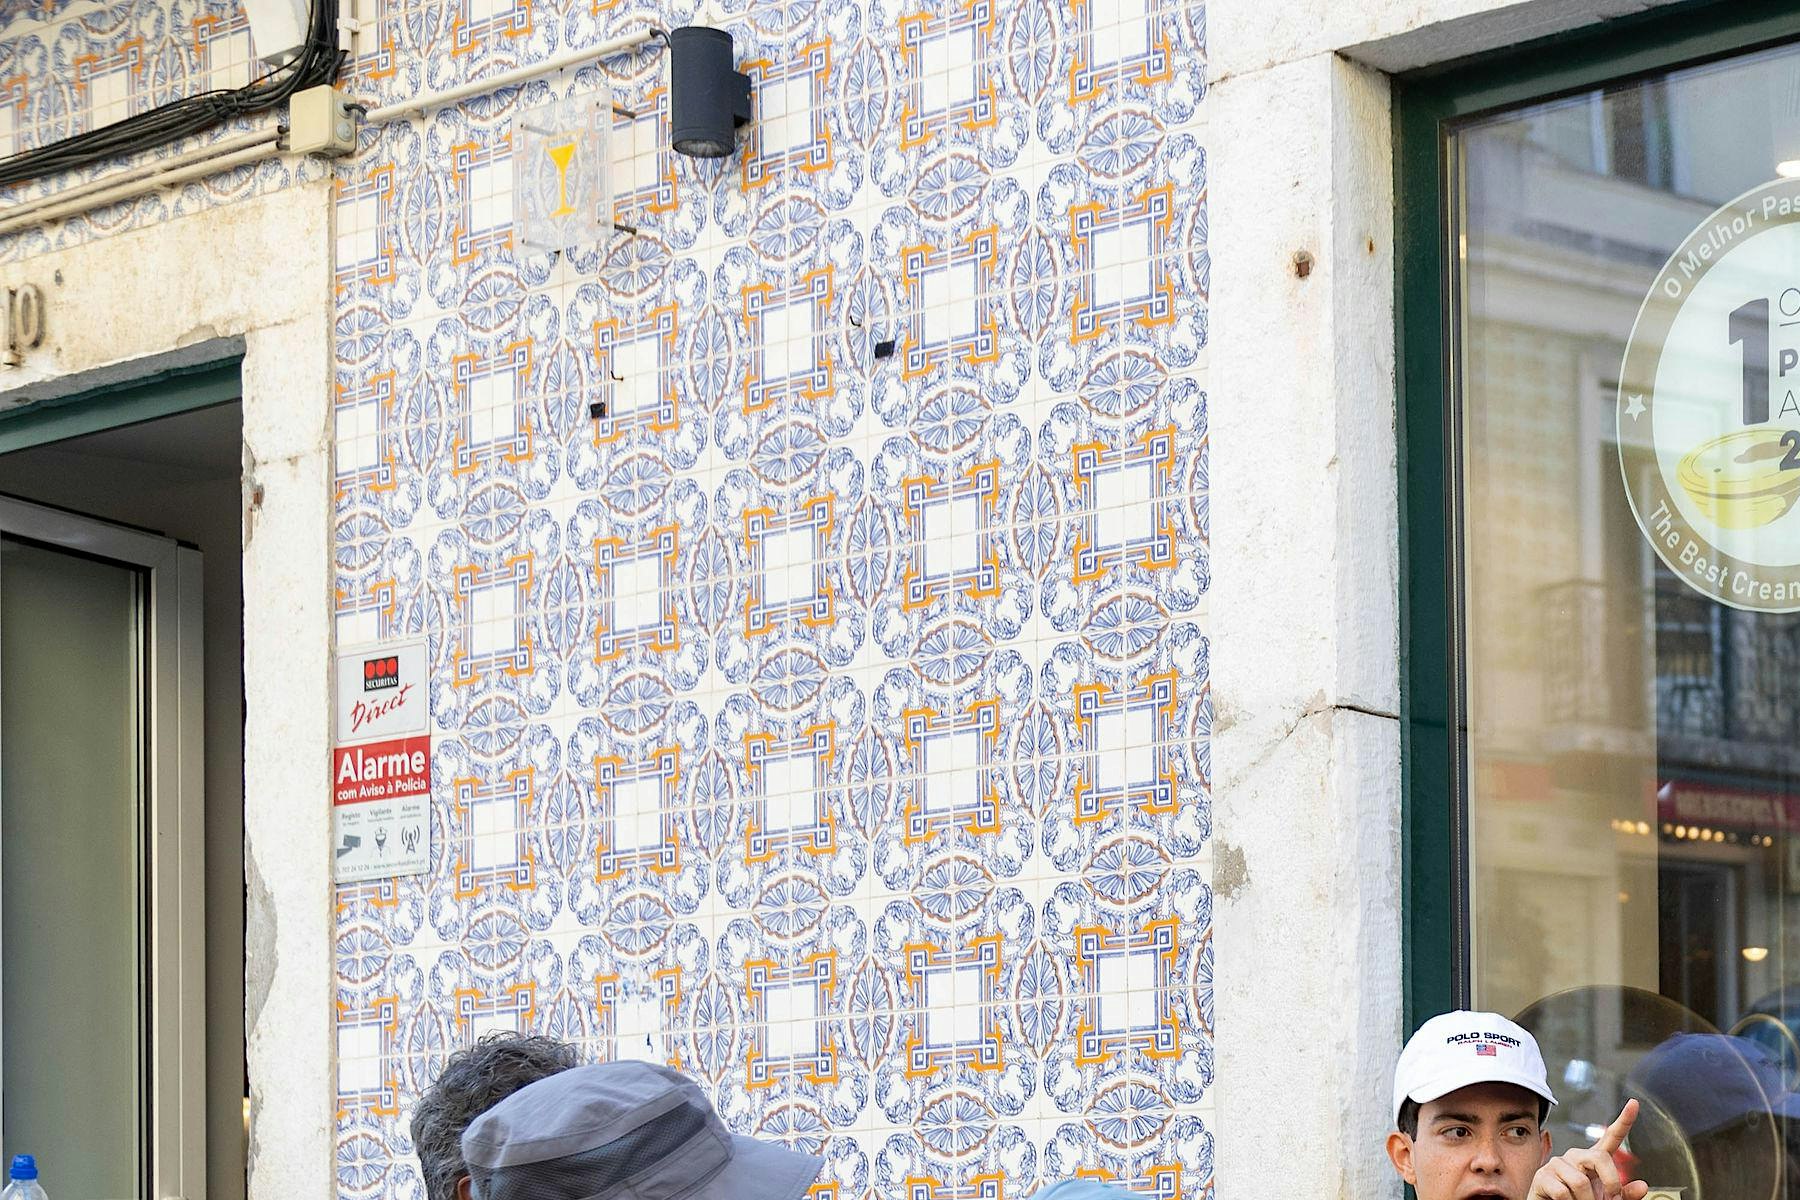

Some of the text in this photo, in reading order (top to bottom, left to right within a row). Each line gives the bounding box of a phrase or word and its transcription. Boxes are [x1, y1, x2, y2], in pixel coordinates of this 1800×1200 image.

[1663, 277, 1683, 298] O
[1678, 209, 1756, 279] Melhor
[1650, 499, 1680, 548] The
[1679, 540, 1728, 588] Best
[366, 677, 398, 690] SECURITAS
[350, 683, 416, 733] Direct
[337, 748, 426, 784] Alarme
[337, 788, 357, 800] com
[359, 783, 385, 798] Aviso
[1447, 1032, 1521, 1047] POLO SPORT
